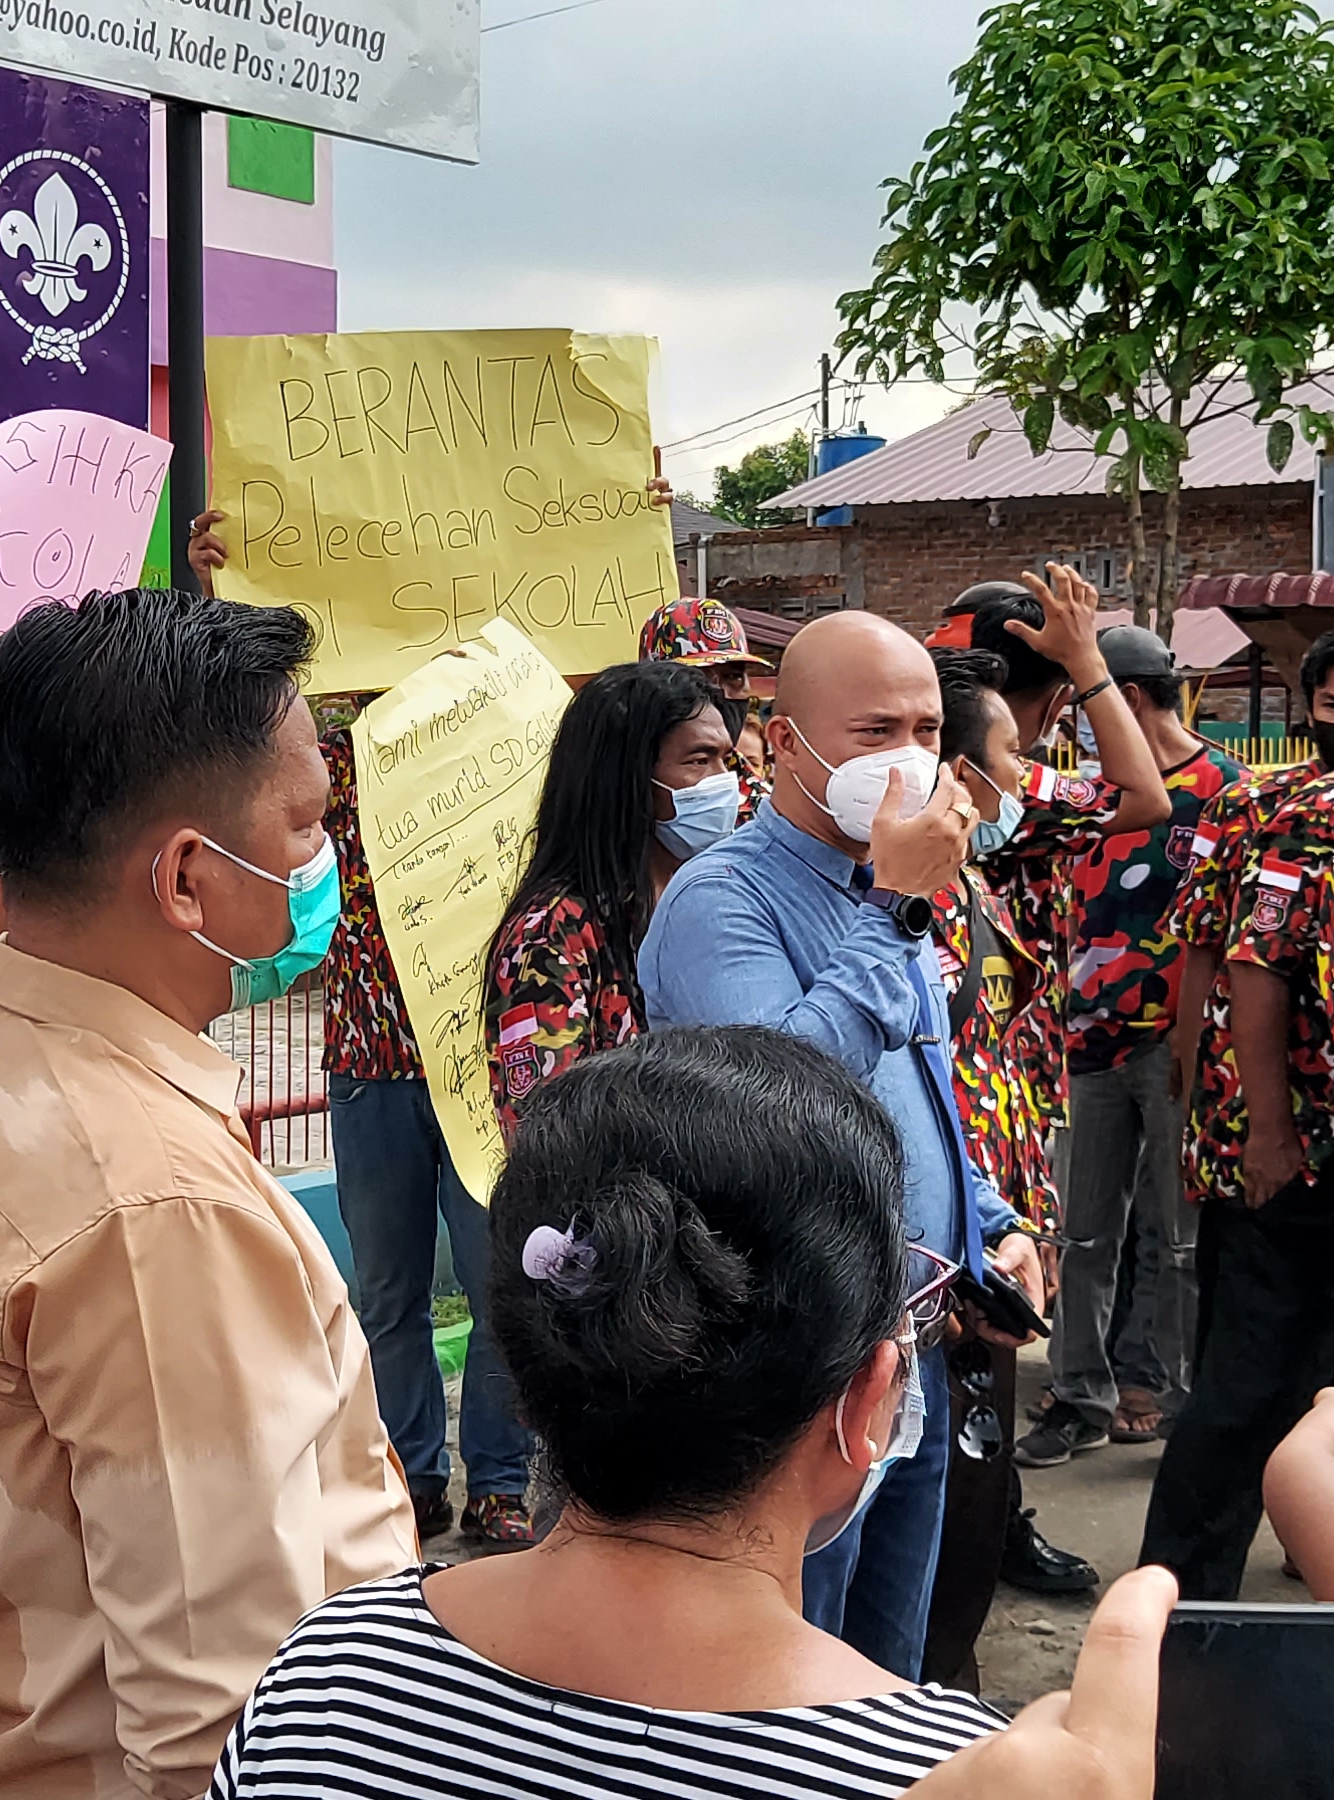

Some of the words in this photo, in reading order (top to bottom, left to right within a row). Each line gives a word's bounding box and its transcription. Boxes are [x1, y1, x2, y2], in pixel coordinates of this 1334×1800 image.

[168, 27, 227, 71] Kode
[232, 43, 274, 82] Pos
[291, 58, 360, 102] 20132
[279, 353, 619, 462] BERANTAS
[242, 473, 497, 570] Pelecehan
[503, 465, 664, 536] Seksual
[392, 551, 666, 653] SEKOLAH
[375, 810, 419, 850] tua
[490, 737, 524, 776] SD
